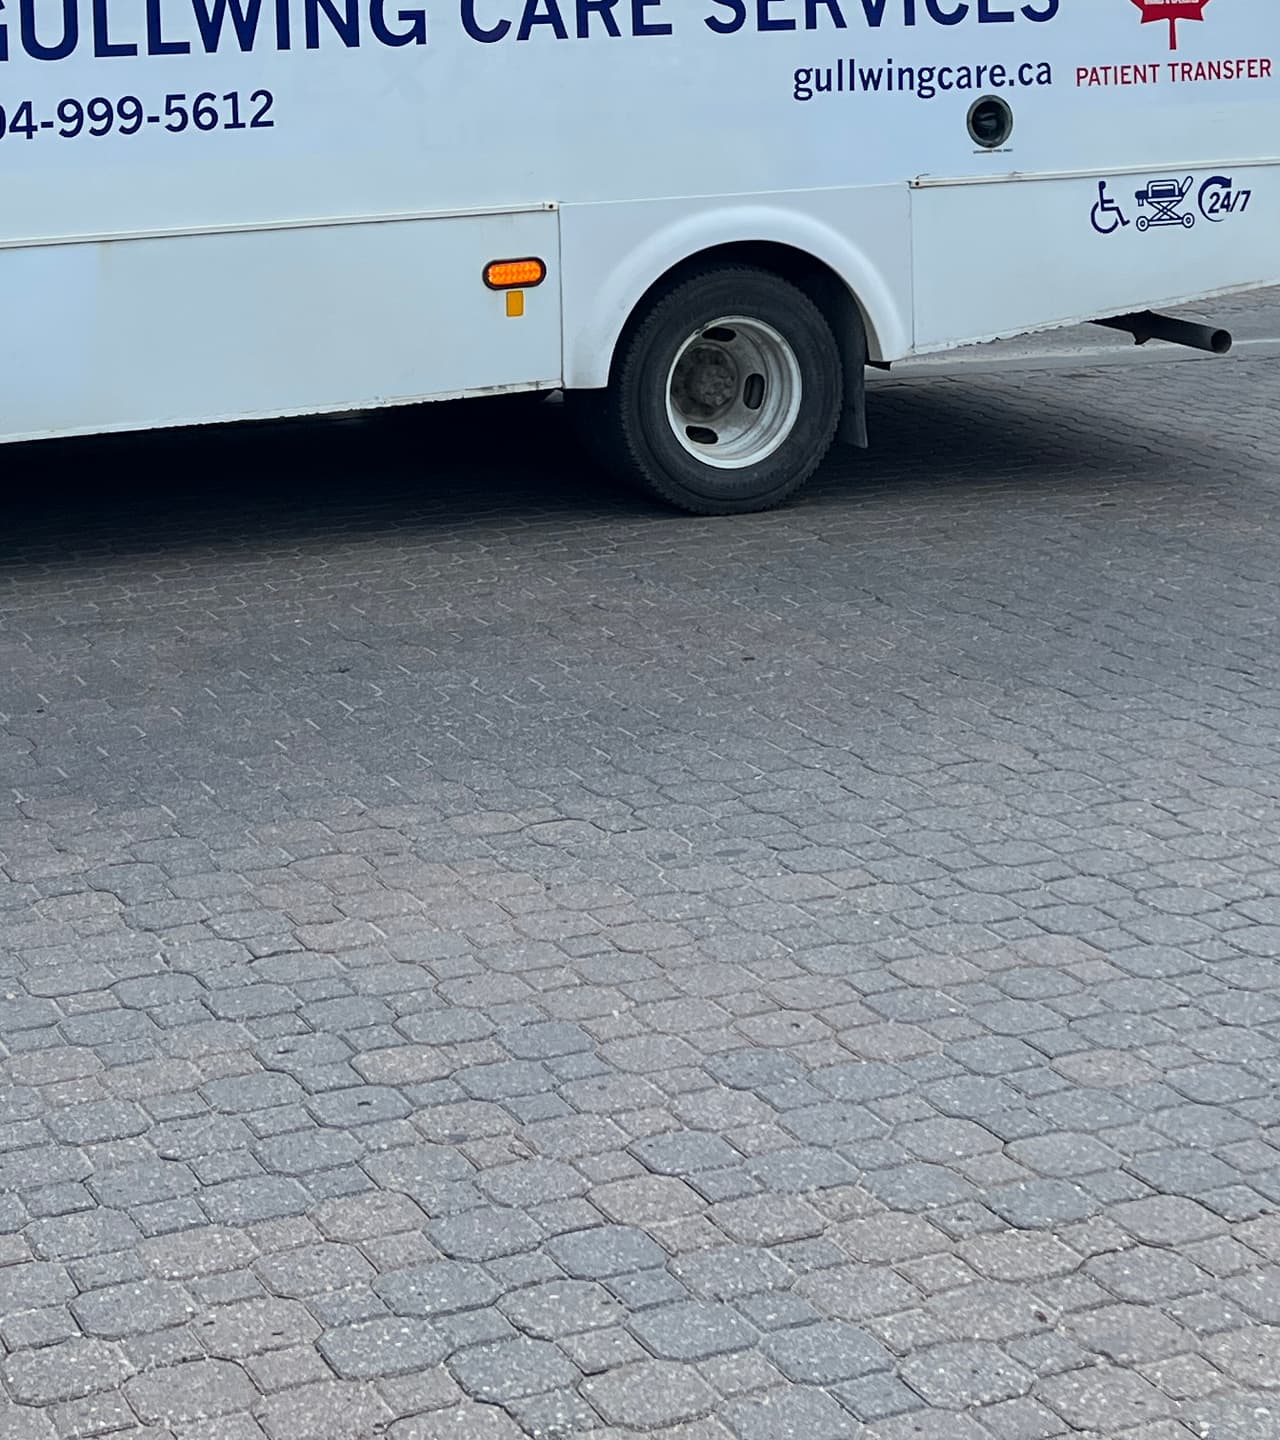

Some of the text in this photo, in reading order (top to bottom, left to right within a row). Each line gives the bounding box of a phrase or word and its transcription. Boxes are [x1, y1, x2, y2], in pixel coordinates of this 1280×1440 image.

[792, 57, 1272, 102] gullwingcare.ca PATIENT TRANSFER
[1207, 189, 1252, 215] 24/7
